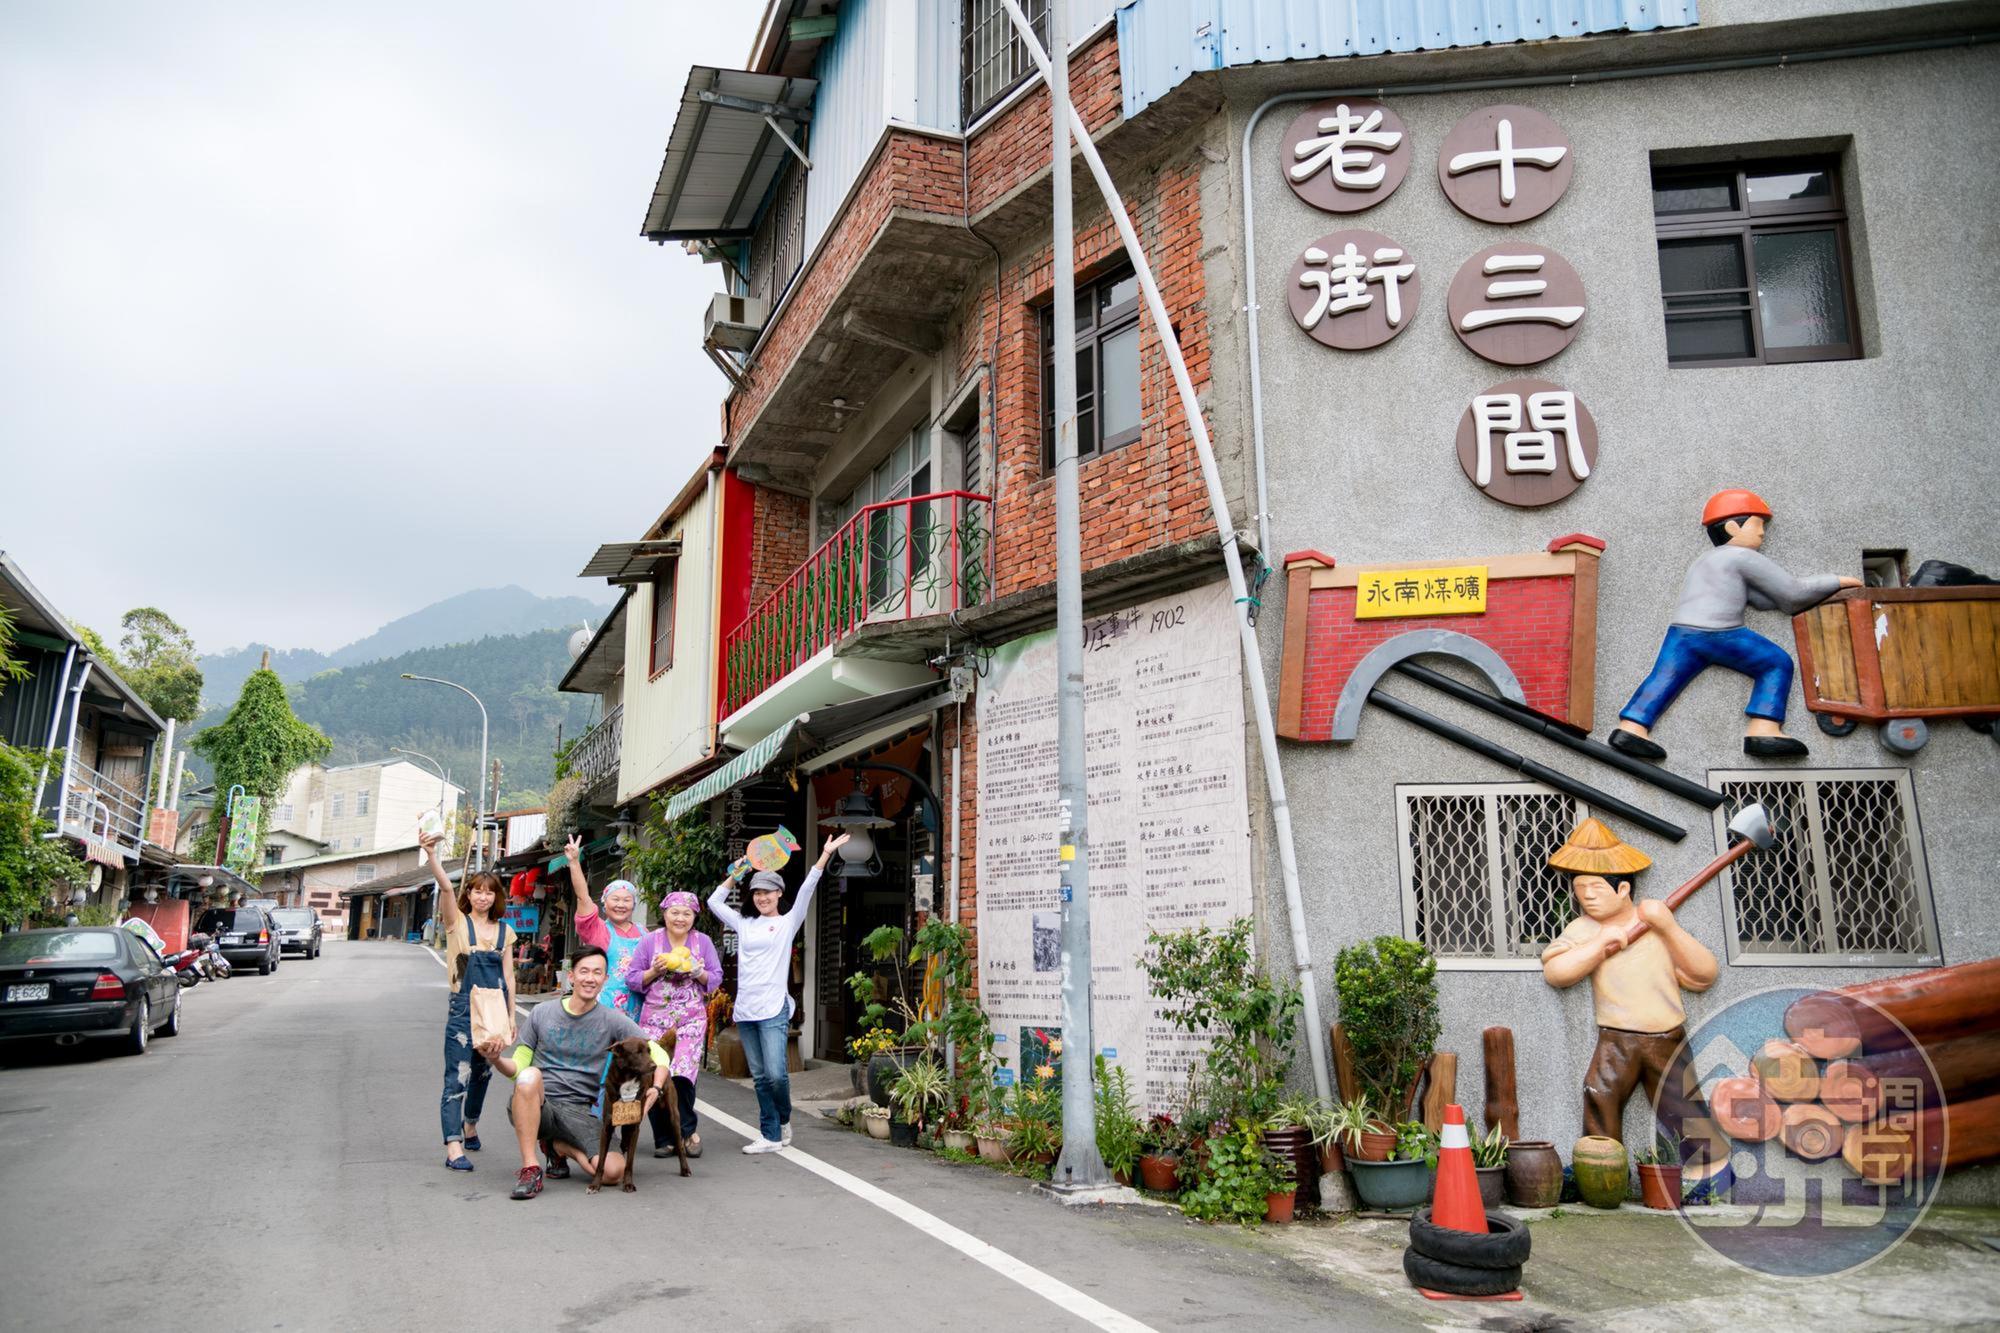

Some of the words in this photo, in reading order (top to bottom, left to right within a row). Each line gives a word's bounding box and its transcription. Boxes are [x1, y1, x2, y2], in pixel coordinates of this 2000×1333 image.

[1289, 104, 1416, 330] 老街
[1448, 119, 1590, 488] 十三間
[1082, 606, 1142, 652] 庄事件
[1150, 605, 1185, 634] 1902
[1367, 578, 1481, 607] 永南煤礦
